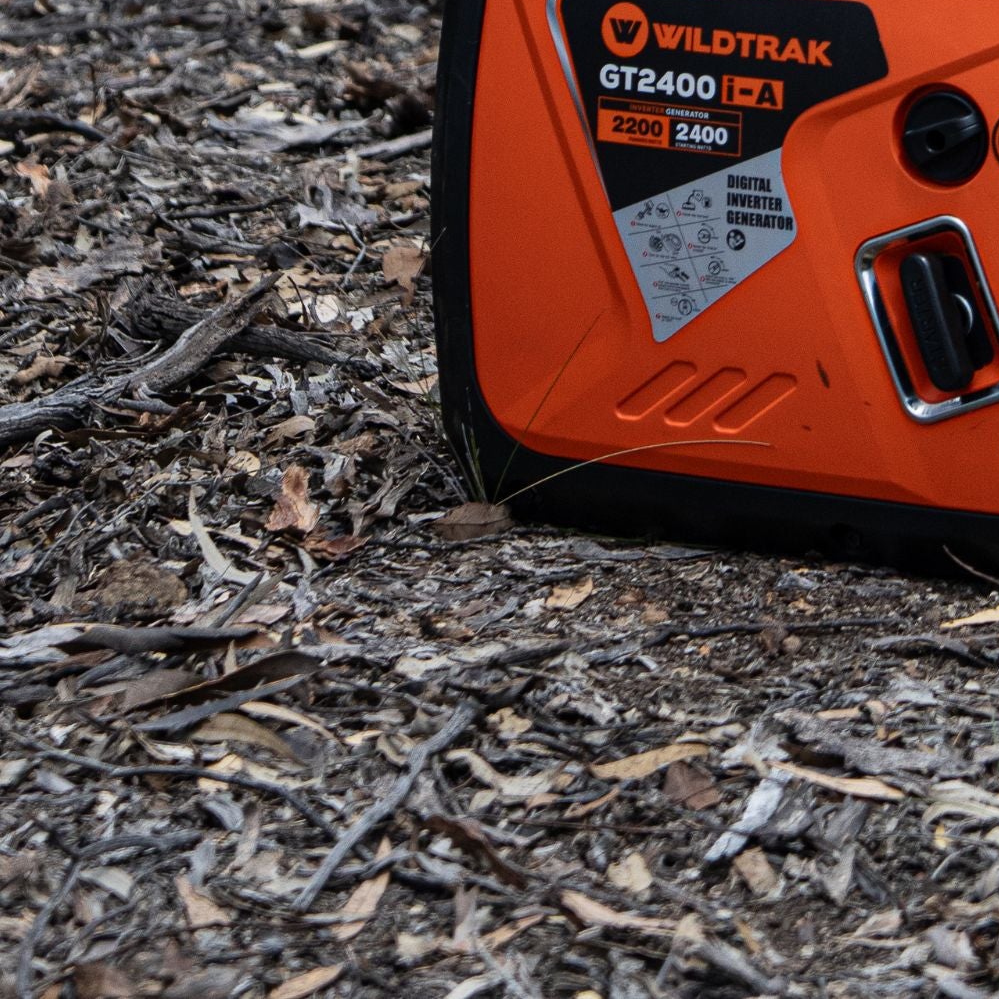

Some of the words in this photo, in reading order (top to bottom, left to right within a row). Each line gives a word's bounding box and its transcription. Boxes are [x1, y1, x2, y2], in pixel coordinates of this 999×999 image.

[609, 18, 642, 45] W
[652, 22, 832, 67] WILDTRAK
[599, 63, 716, 101] GT2400
[726, 78, 778, 106] i-A
[665, 107, 709, 119] GENERATOR
[612, 115, 663, 137] 2200
[675, 122, 728, 145] 2400
[727, 174, 772, 193] DIGITAL
[727, 192, 782, 212] INVERTER
[726, 210, 793, 231] GENERATOR
